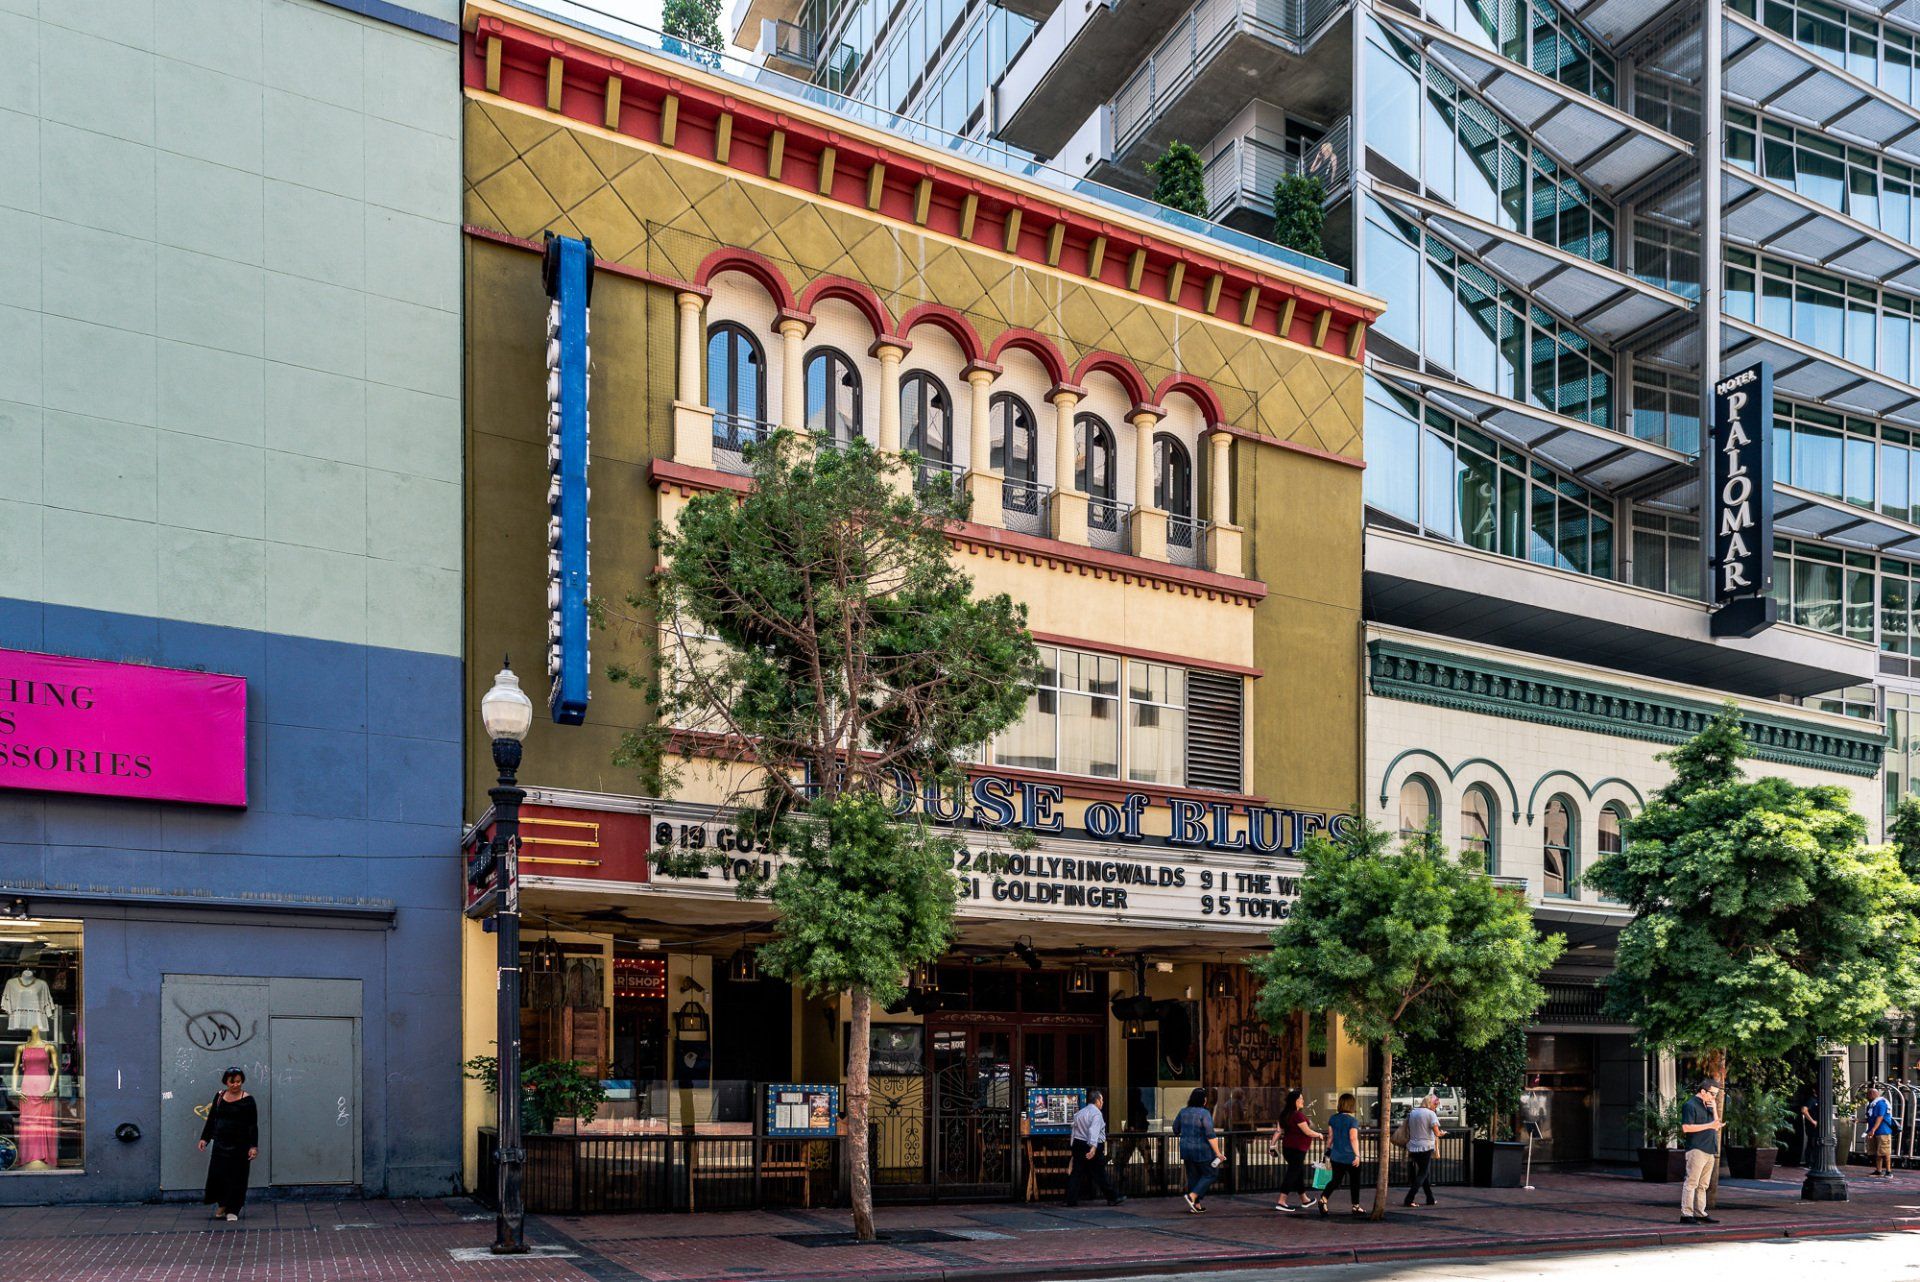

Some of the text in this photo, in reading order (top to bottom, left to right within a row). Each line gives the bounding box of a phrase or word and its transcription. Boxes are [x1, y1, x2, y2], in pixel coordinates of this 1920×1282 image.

[1719, 391, 1755, 592] PALOMAR
[1084, 792, 1151, 840] of
[1166, 797, 1362, 862] BLUES
[992, 880, 1128, 909] GOLDFINGER
[1235, 872, 1272, 894] THE
[628, 976, 661, 987] SHOP
